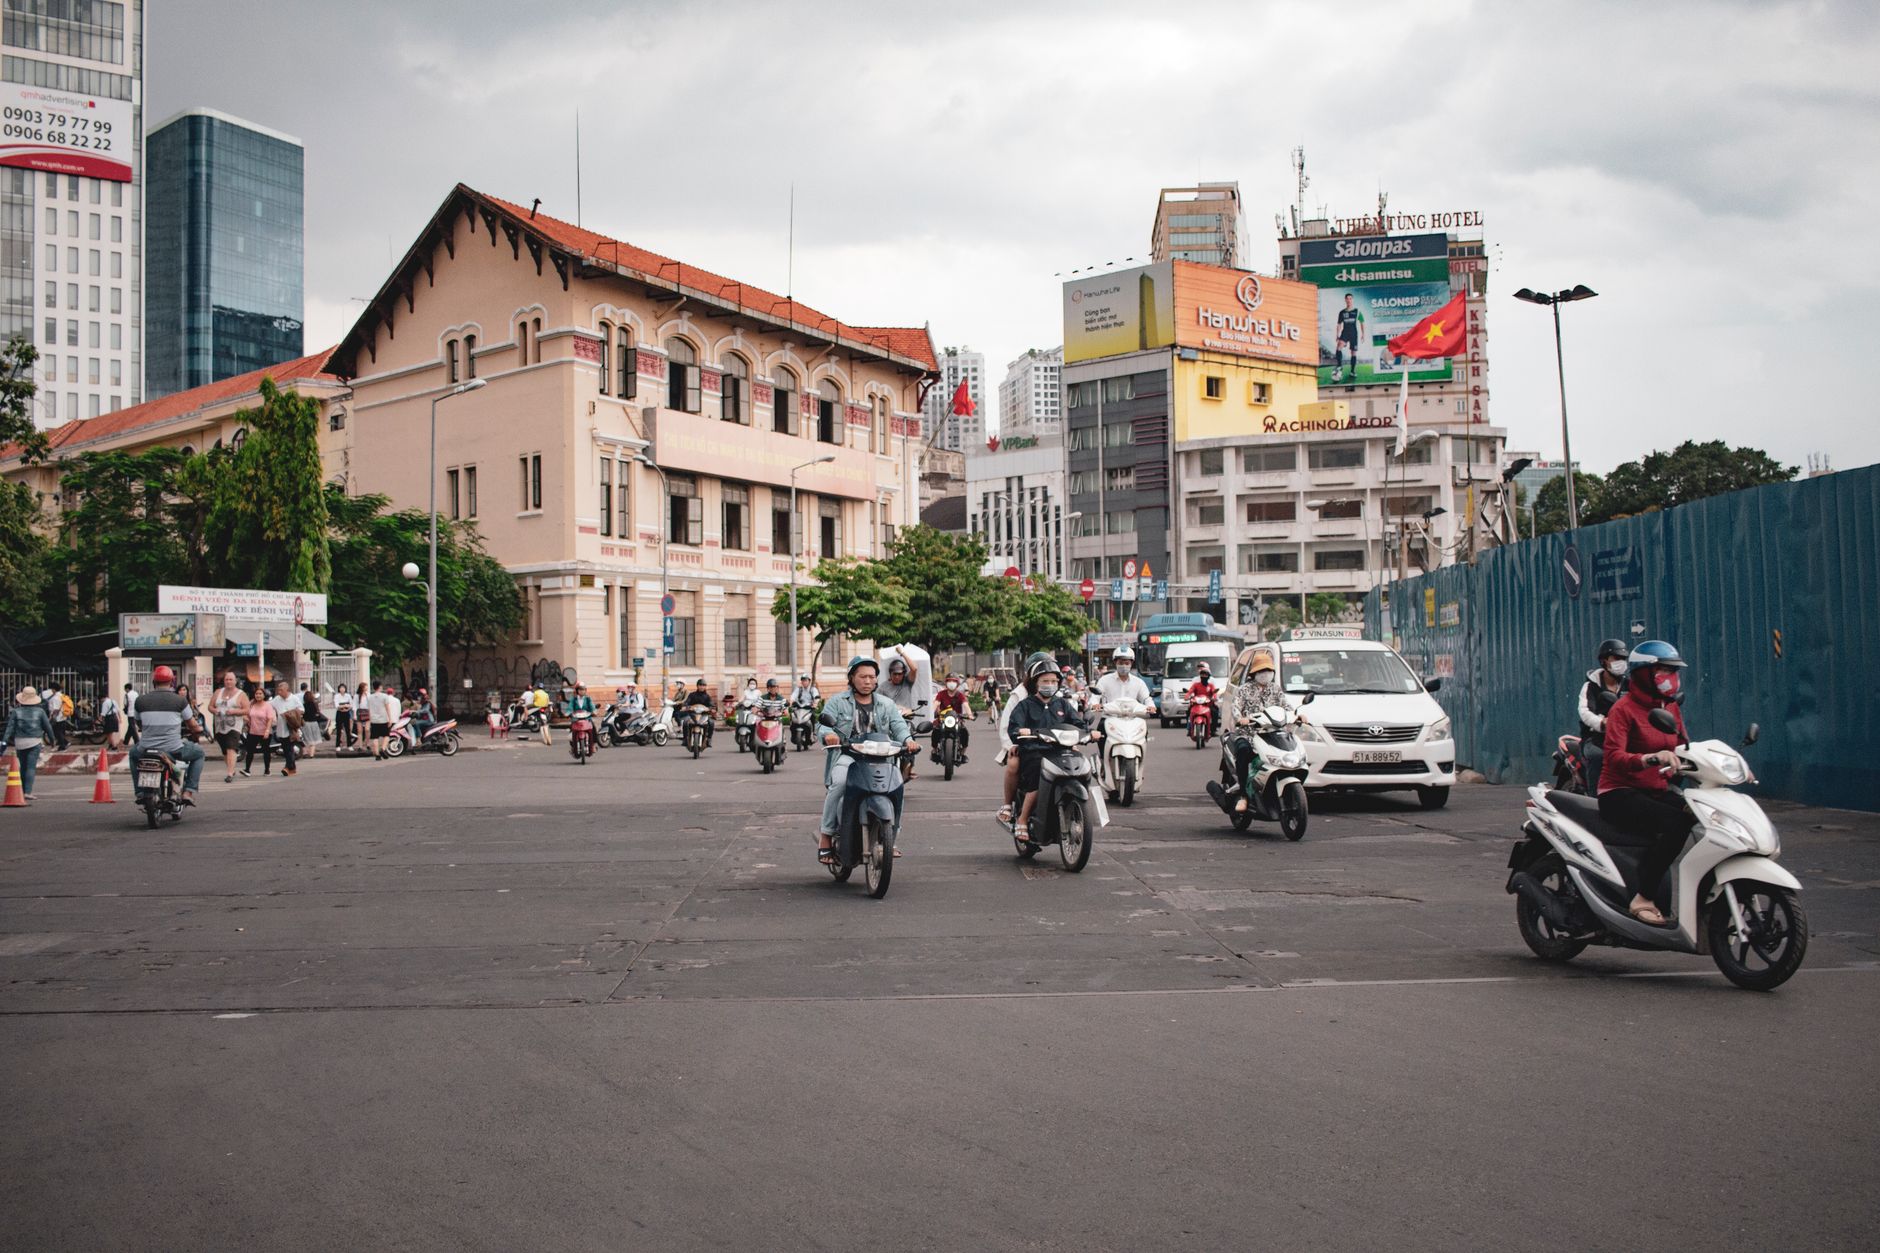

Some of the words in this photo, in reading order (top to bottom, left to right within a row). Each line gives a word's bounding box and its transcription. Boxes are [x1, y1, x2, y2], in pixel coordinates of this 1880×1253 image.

[20, 89, 89, 109] qmhadvertising
[3, 107, 43, 123] 0903
[48, 113, 67, 127] 79
[70, 117, 89, 130] 77
[93, 121, 112, 134] 99
[3, 124, 43, 141] 0906
[47, 131, 66, 144] 68
[70, 134, 89, 148] 22
[93, 137, 112, 151] 22
[1388, 211, 1427, 231] TÙNG
[1431, 211, 1483, 228] HOTEL
[1334, 240, 1412, 259] Salonpas
[1334, 268, 1413, 282] Hisamitsu
[1371, 297, 1420, 309] SALONSIP
[1199, 306, 1269, 334] Hanwha
[1271, 319, 1301, 341] Life
[1002, 435, 1039, 450] VPBank
